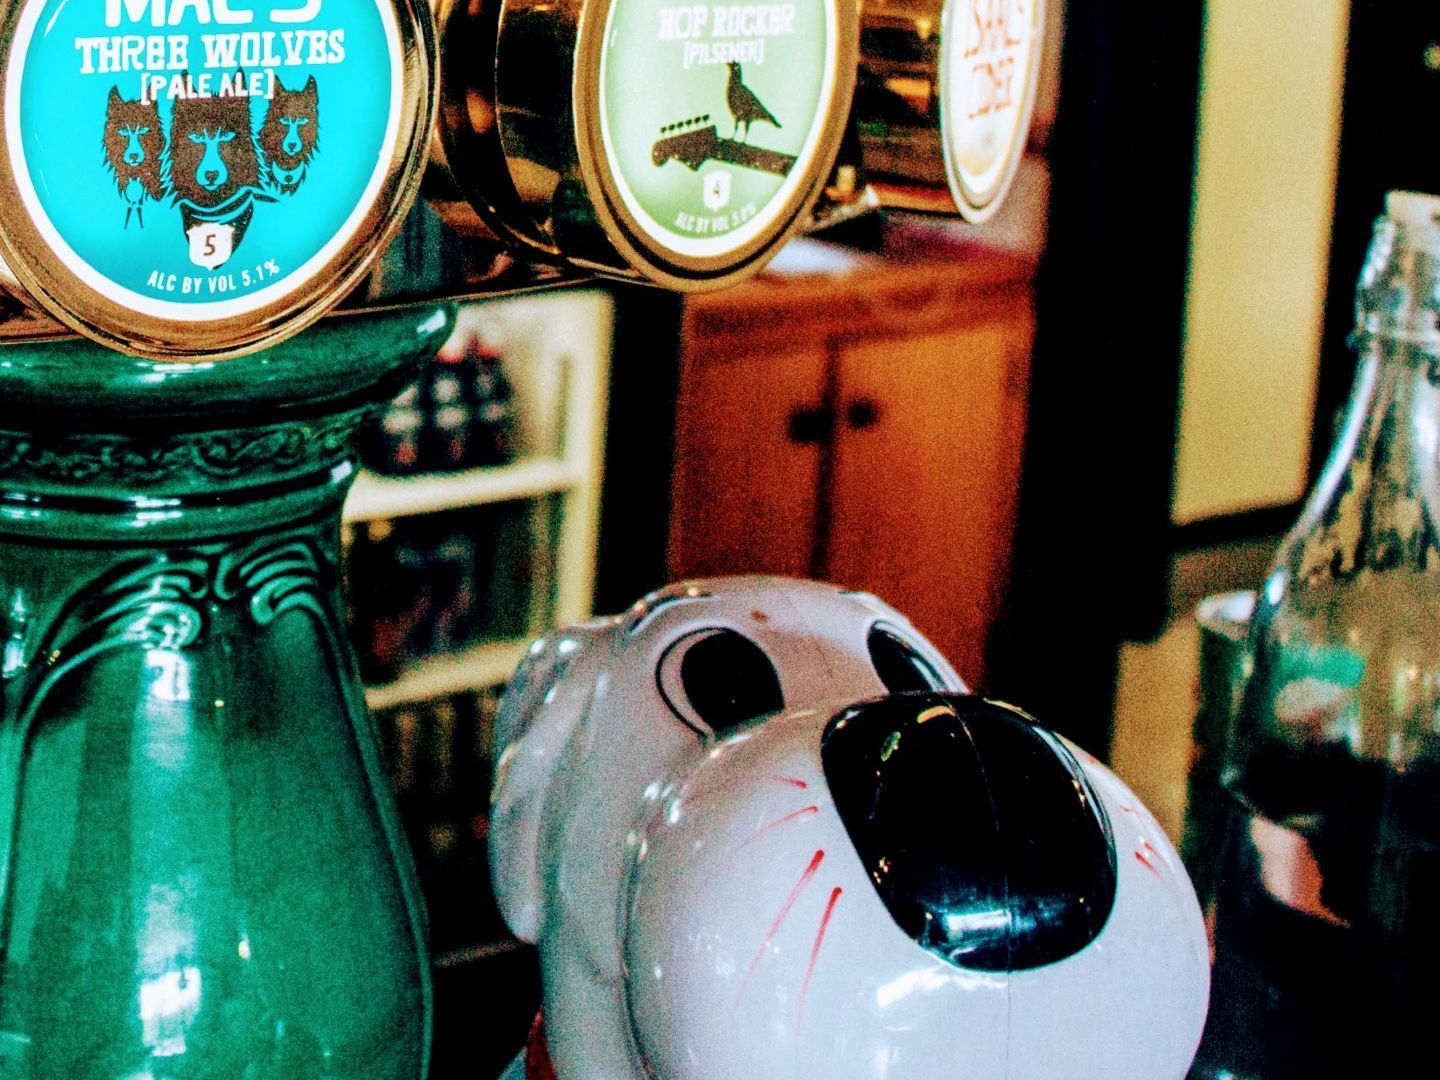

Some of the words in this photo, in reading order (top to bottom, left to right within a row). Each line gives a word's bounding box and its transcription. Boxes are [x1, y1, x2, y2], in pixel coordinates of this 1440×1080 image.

[658, 5, 709, 40] HOP
[711, 3, 797, 38] ROCKER
[74, 34, 189, 74] THREE
[202, 29, 346, 71] WOLVES
[203, 234, 216, 256] 5
[147, 270, 177, 292] ALC
[182, 276, 203, 294] BY
[208, 274, 236, 294] VOL
[241, 258, 280, 287] 5.1%
